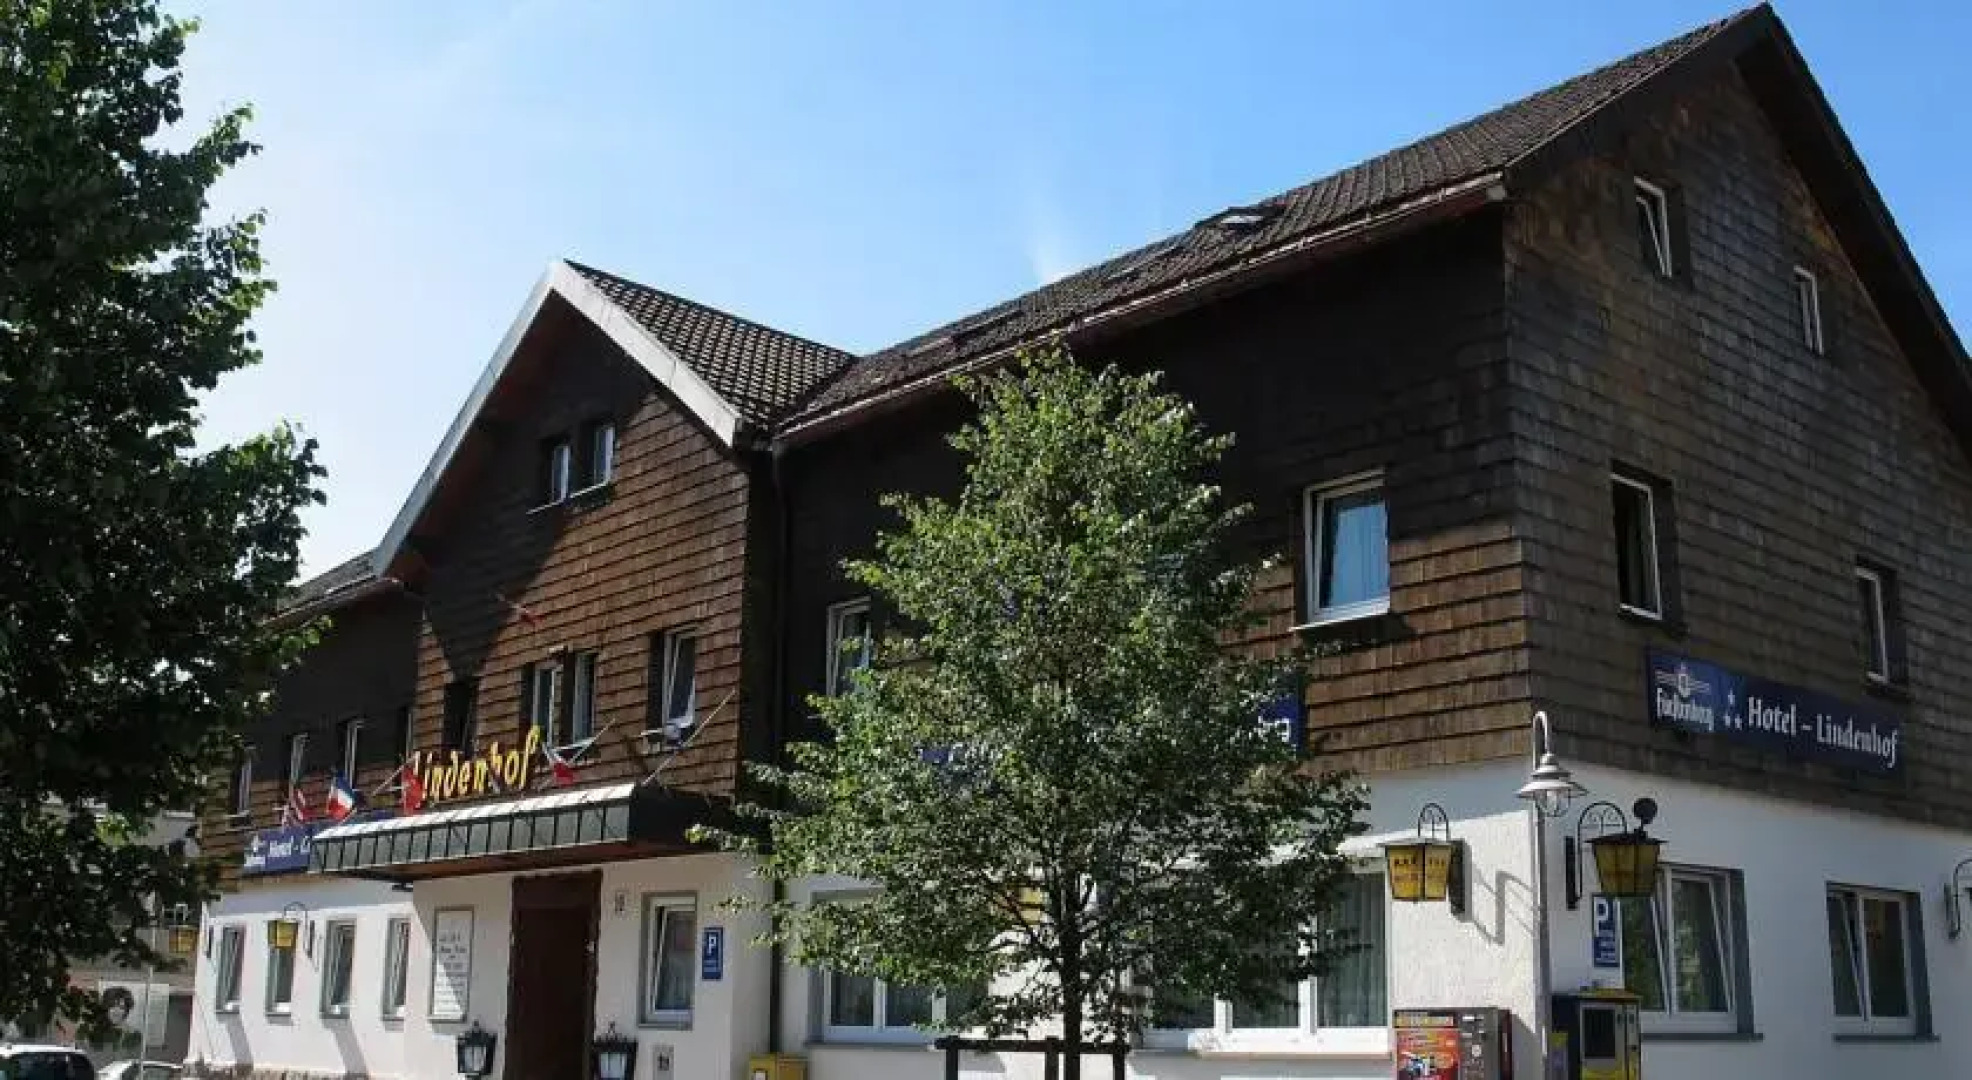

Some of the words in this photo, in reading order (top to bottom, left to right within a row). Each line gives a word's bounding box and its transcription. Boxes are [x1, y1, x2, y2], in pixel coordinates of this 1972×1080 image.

[1748, 696, 1797, 737] Hotel
[1816, 713, 1899, 769] Lindenhof
[1594, 896, 1609, 937] P
[708, 934, 717, 954] P
